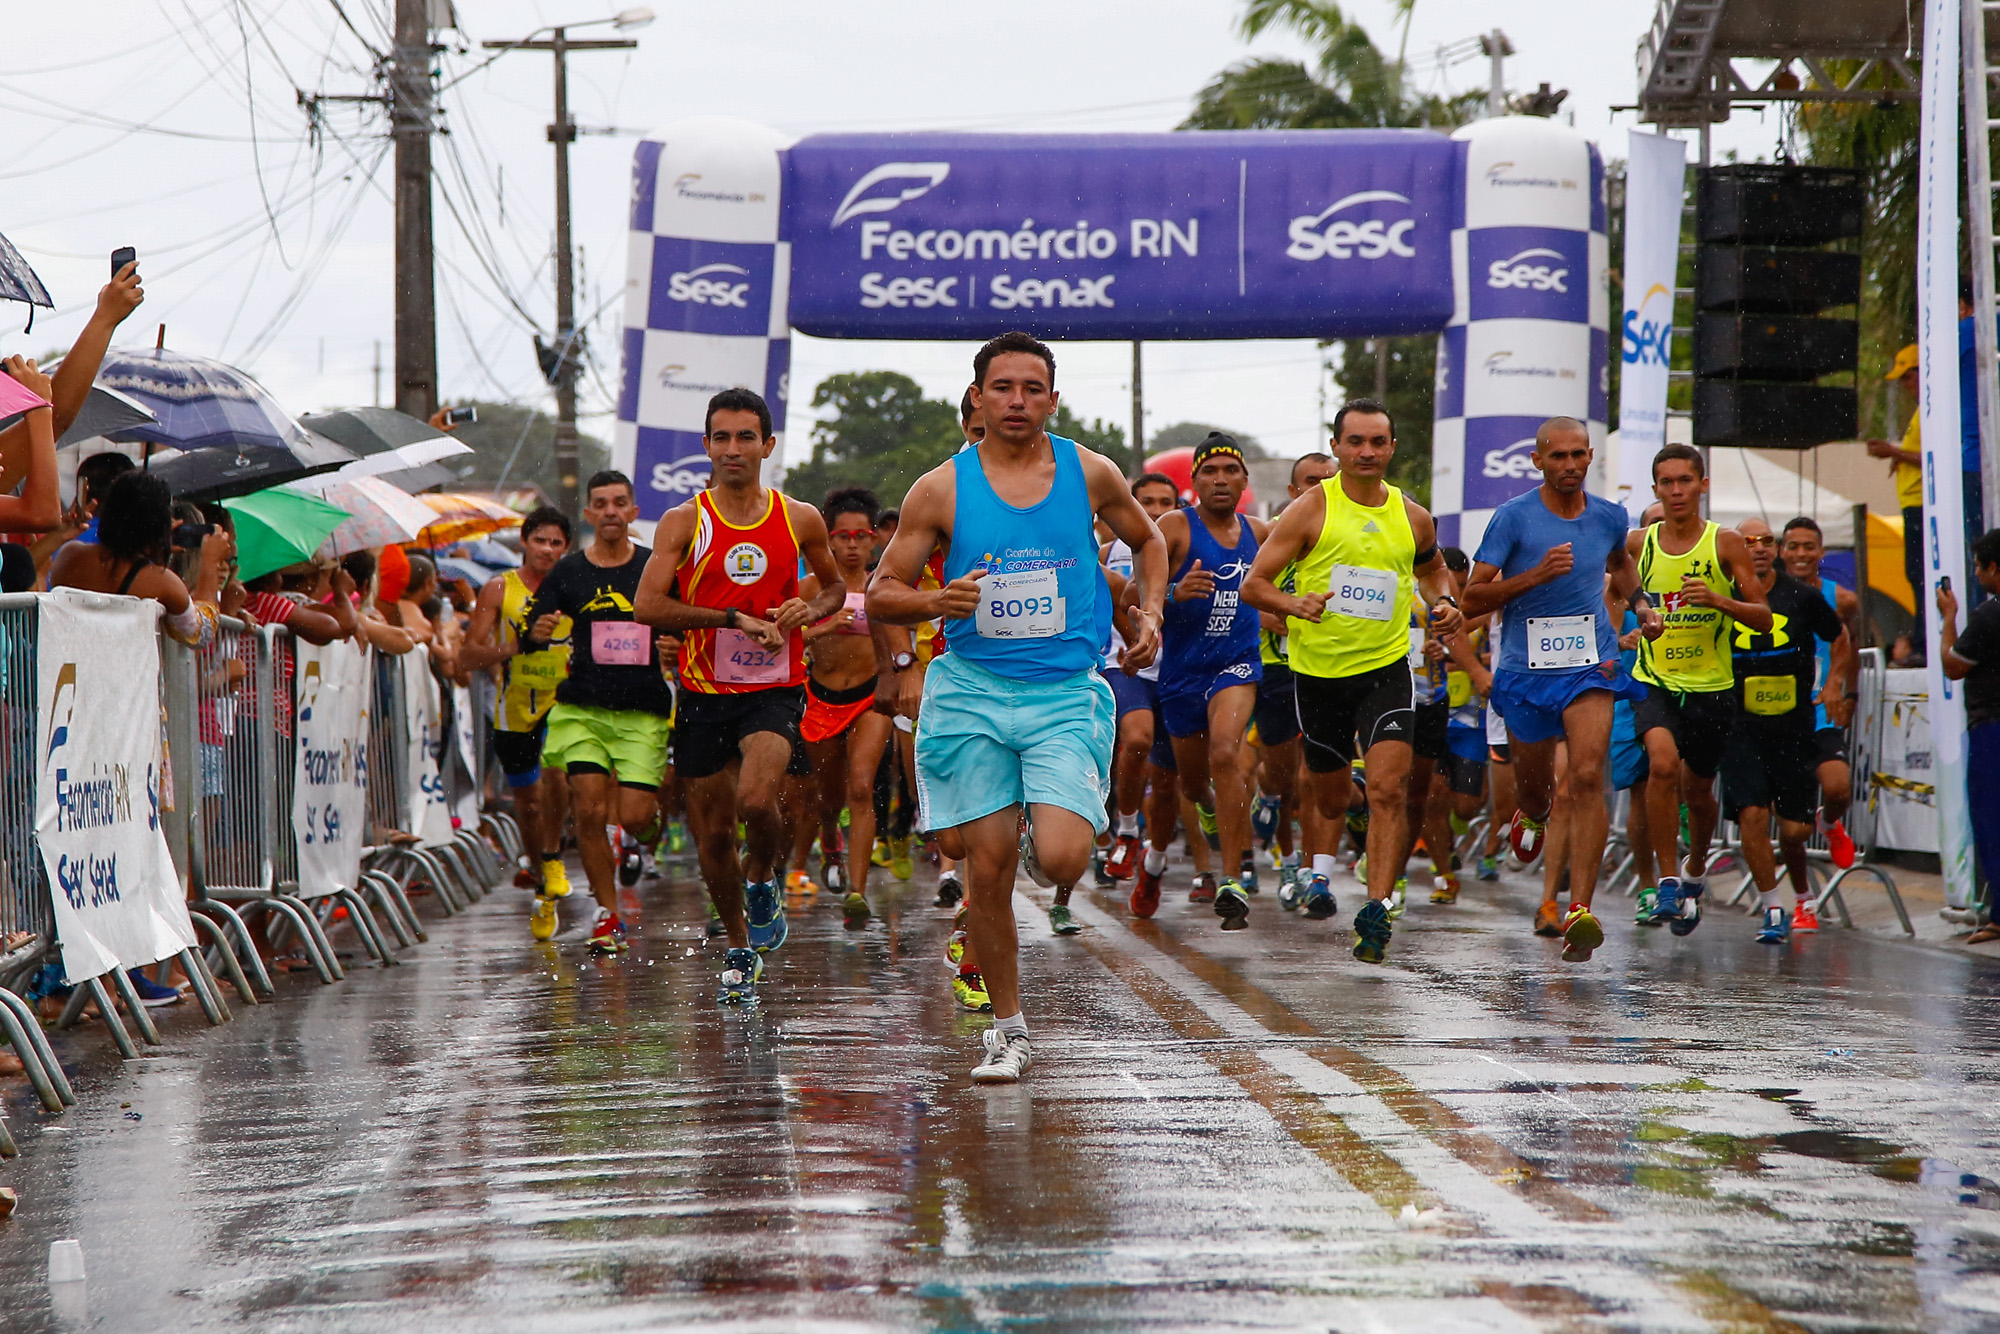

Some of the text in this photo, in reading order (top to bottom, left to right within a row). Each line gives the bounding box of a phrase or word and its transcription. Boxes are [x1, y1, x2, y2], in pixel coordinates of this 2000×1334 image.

[860, 217, 1199, 260] Fecomércio RN
[1286, 214, 1417, 261] Sesc
[1487, 259, 1569, 293] Sesc
[667, 271, 749, 308] Sesc
[859, 272, 1116, 309] Sesc Senac
[1005, 547, 1056, 558] Corrida do
[1341, 585, 1386, 603] 8094
[990, 596, 1053, 618] 8093
[1683, 612, 1717, 622] NOVOS
[994, 628, 1014, 636] Sesc
[603, 638, 640, 651] 4265
[1541, 635, 1586, 652] 8078
[730, 650, 776, 666] 4232
[1665, 645, 1704, 660] 8556
[1755, 691, 1791, 703] 8546
[56, 762, 114, 832] Fecomércio
[115, 762, 132, 823] RN
